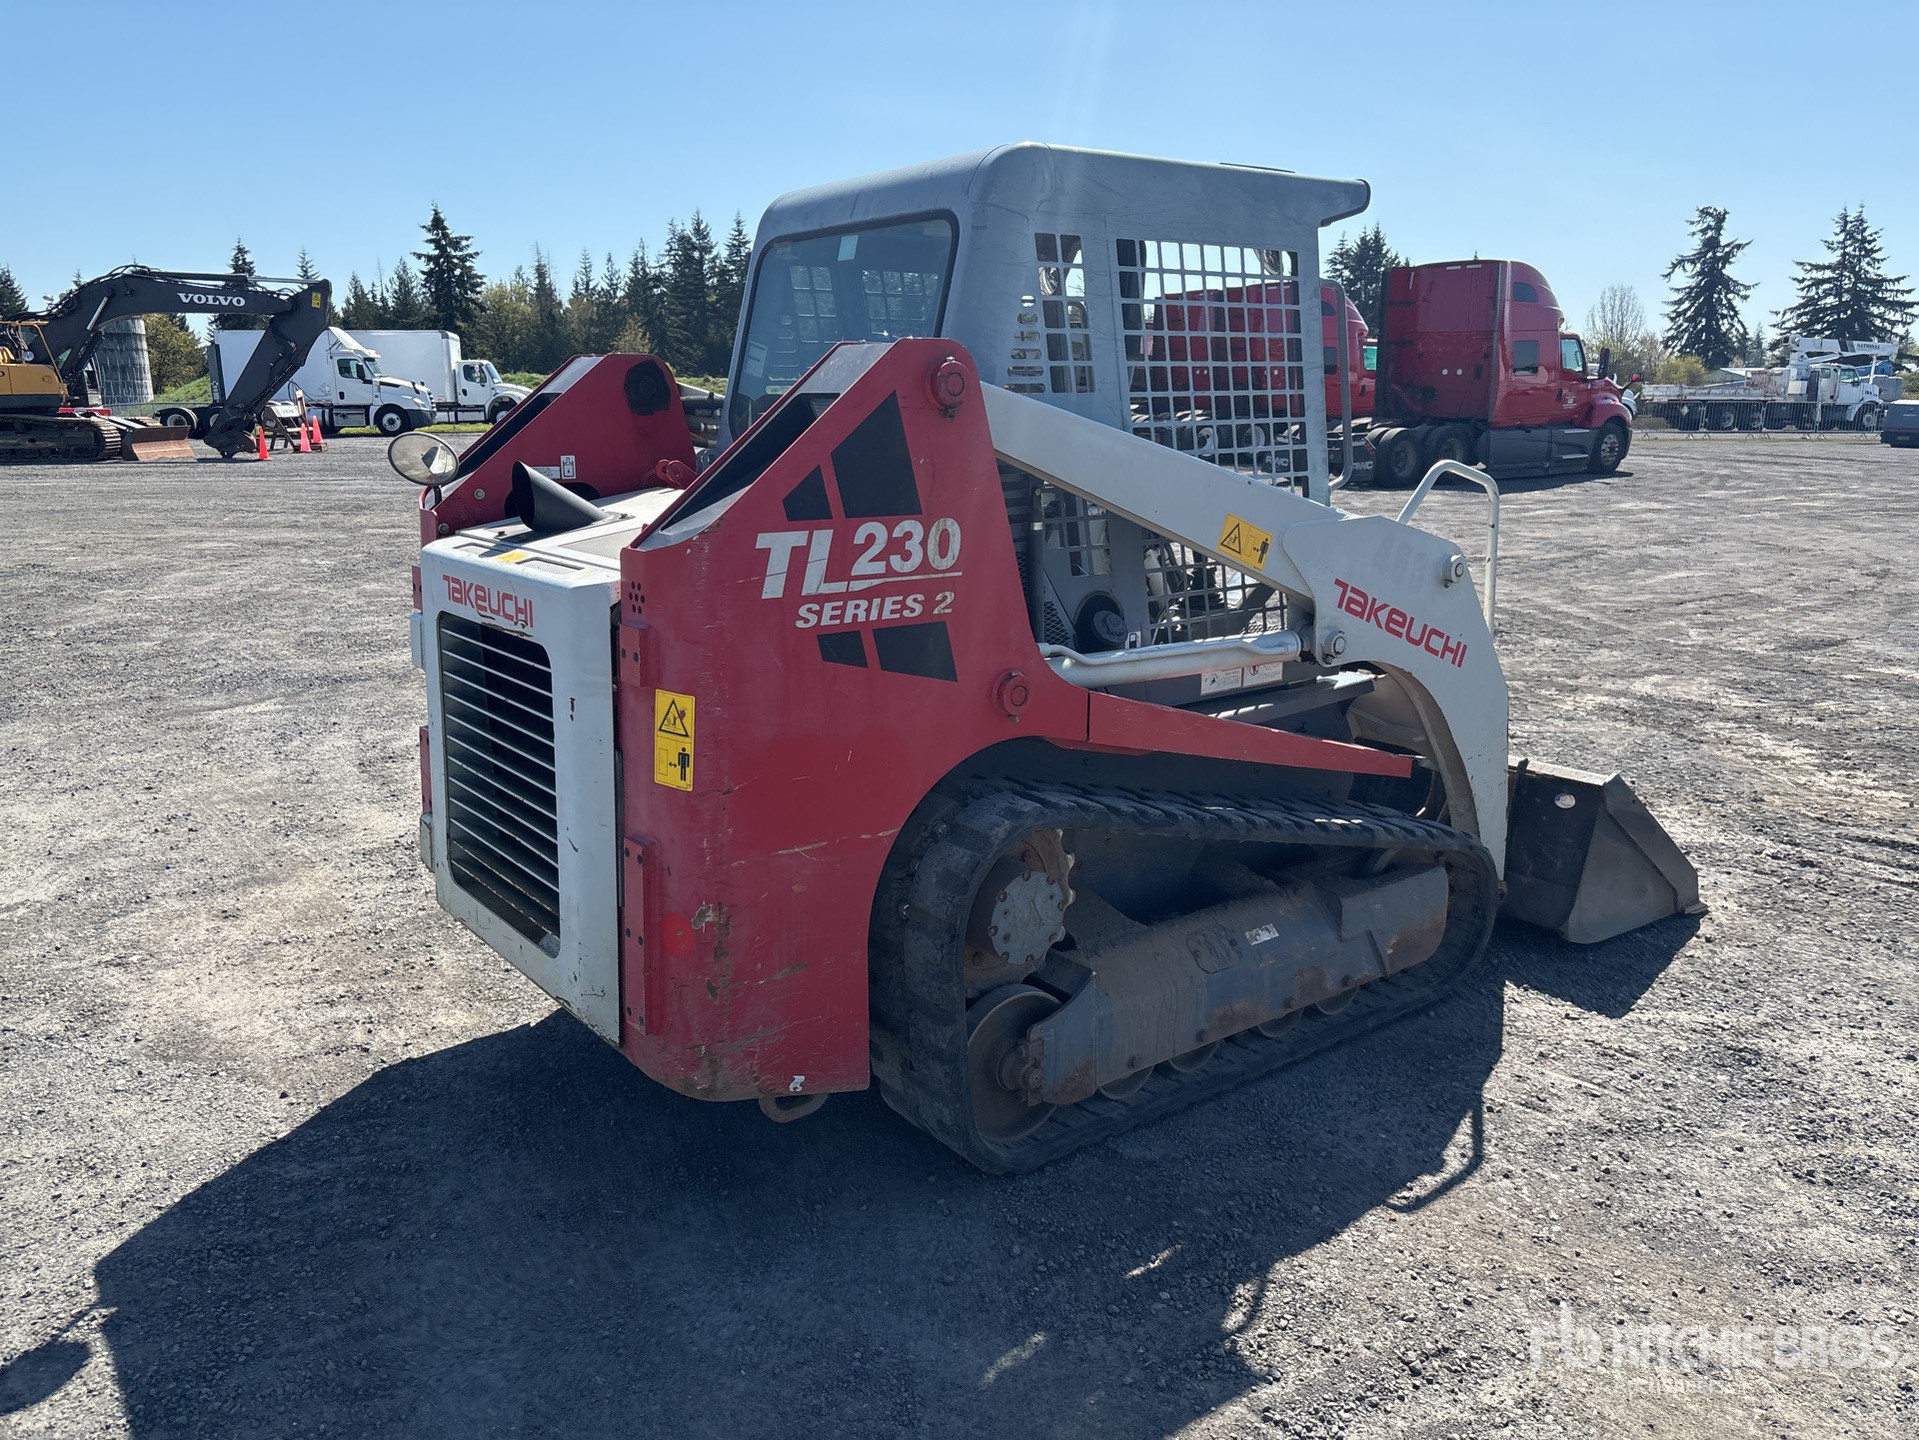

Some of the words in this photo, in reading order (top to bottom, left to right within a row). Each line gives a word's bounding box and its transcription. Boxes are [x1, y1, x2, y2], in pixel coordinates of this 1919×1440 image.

[177, 293, 246, 307] VOLVO
[755, 517, 962, 600] TL230
[795, 593, 925, 628] SERIES
[932, 591, 955, 614] 2
